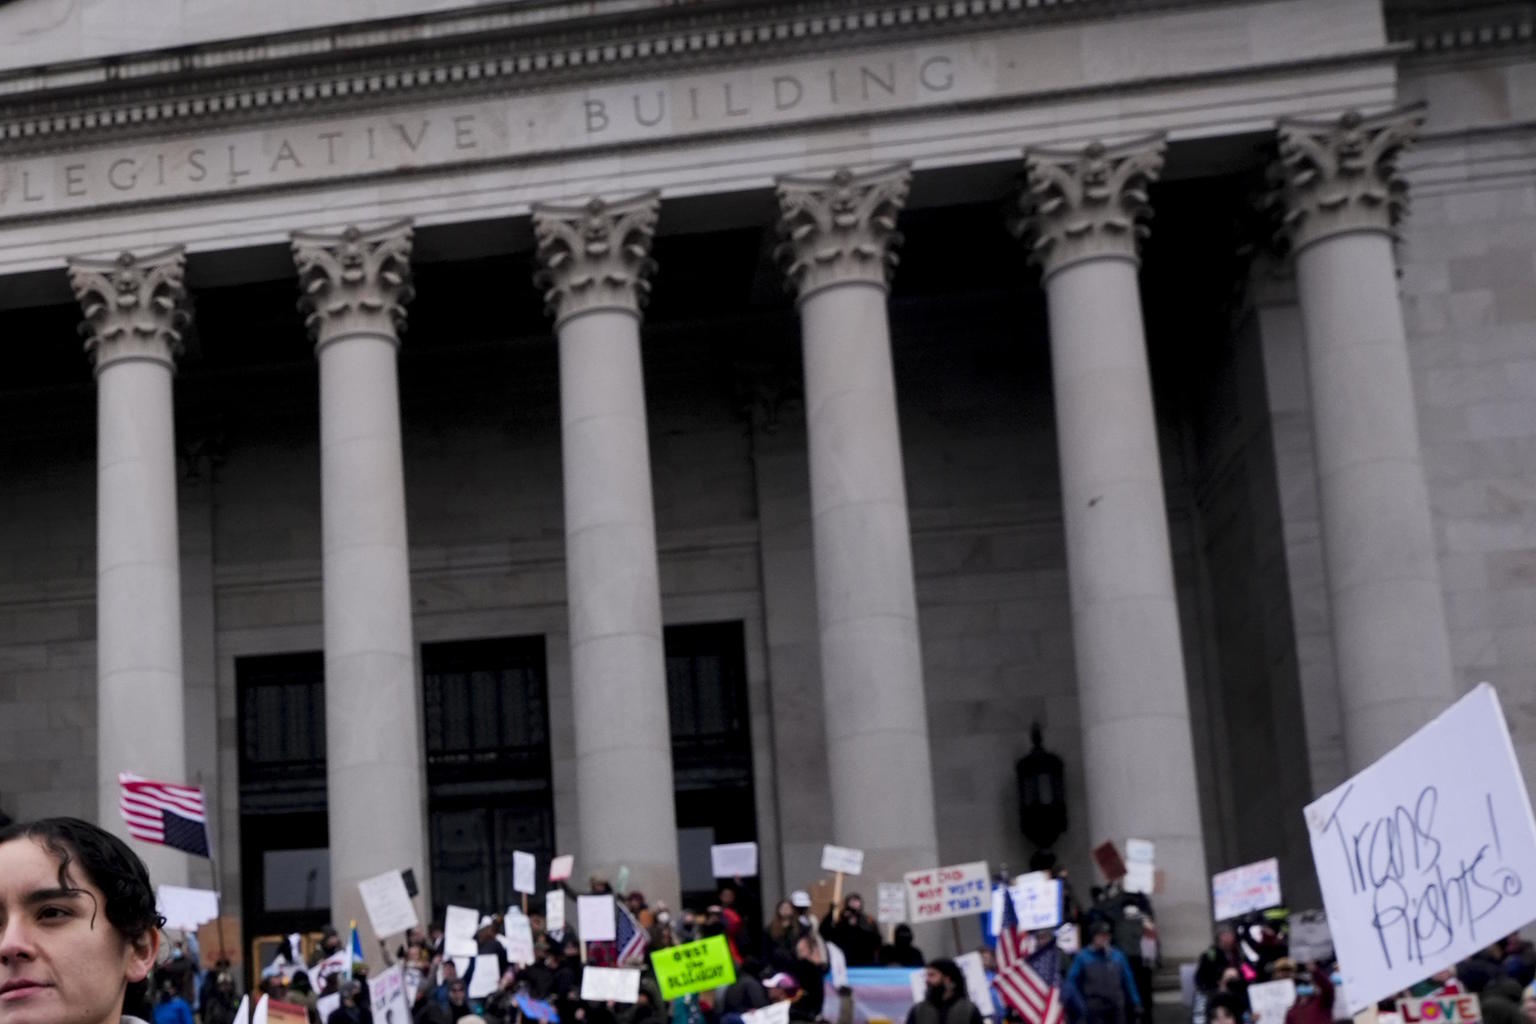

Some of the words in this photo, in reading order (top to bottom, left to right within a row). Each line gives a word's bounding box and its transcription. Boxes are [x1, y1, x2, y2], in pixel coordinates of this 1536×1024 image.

[21, 114, 477, 203] LEGISLATIVE
[583, 55, 955, 134] BUILDING
[1322, 783, 1441, 895] Trans
[1401, 998, 1477, 1024] LOVE
